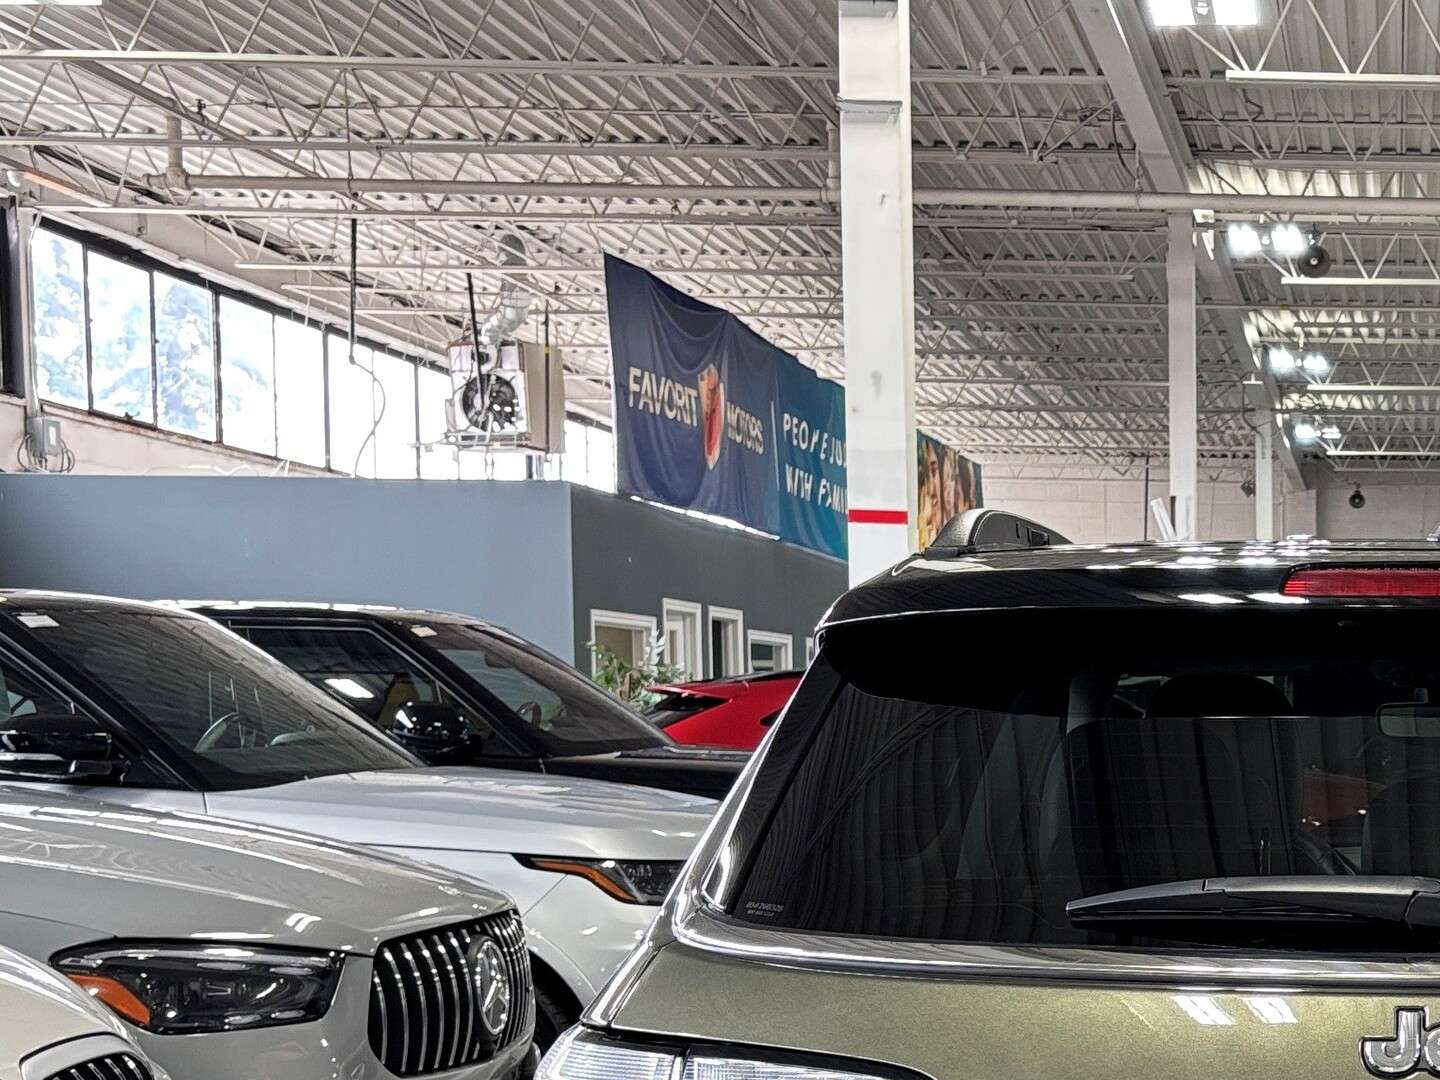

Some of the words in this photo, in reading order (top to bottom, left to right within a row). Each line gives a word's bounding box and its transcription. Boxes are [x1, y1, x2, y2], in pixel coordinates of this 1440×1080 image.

[628, 366, 698, 427] FAVORIT
[726, 401, 764, 455] MOTORS
[785, 463, 813, 502] WITH
